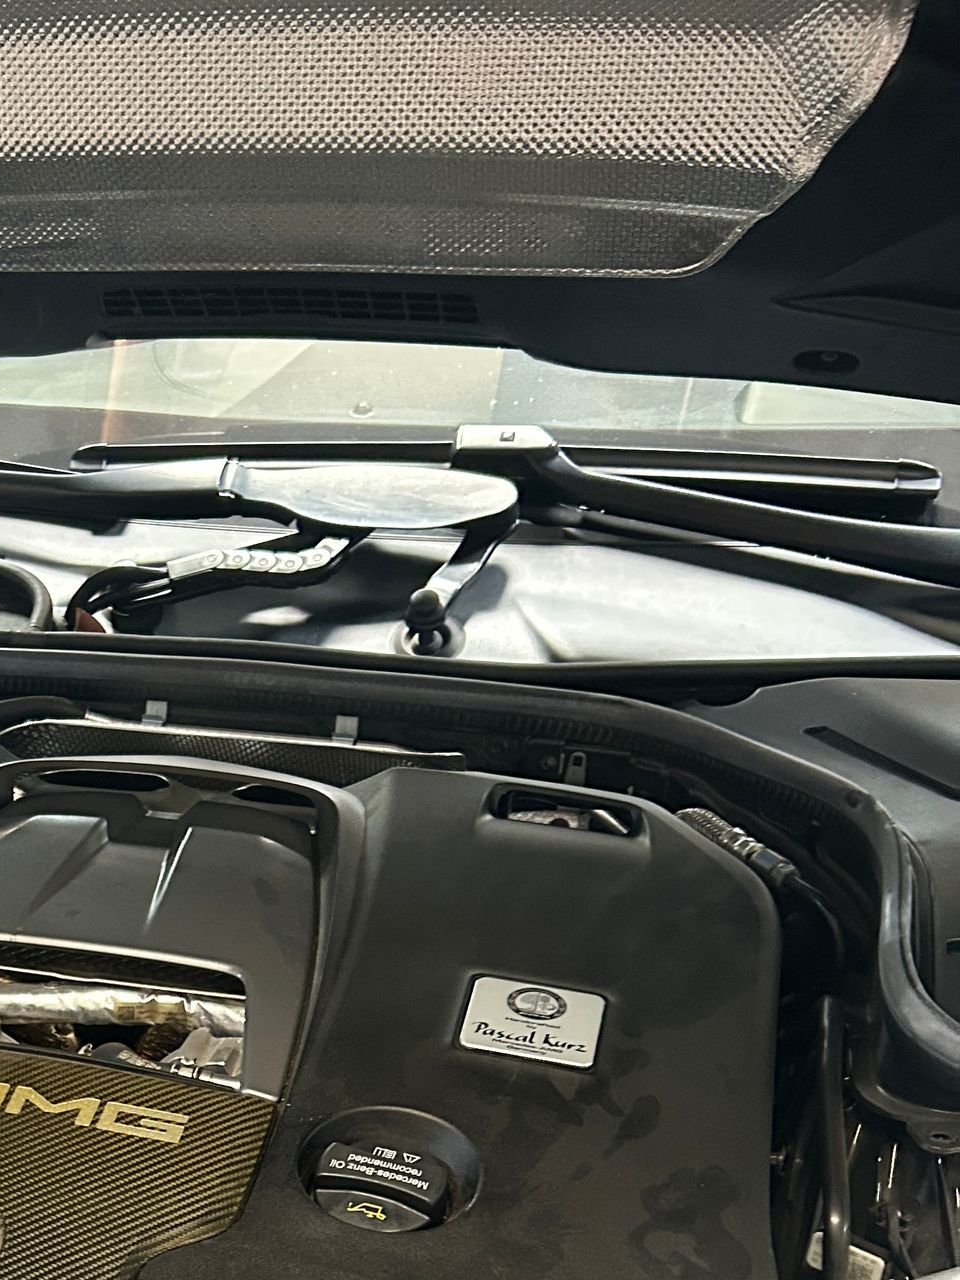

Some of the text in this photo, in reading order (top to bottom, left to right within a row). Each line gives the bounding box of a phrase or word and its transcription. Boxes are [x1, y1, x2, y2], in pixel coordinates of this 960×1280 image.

[472, 1021, 536, 1044] Pascal
[543, 1033, 588, 1053] Kurz
[329, 1158, 430, 1191] Mercedes-Benz Oil
[347, 1153, 423, 1177] recommended
